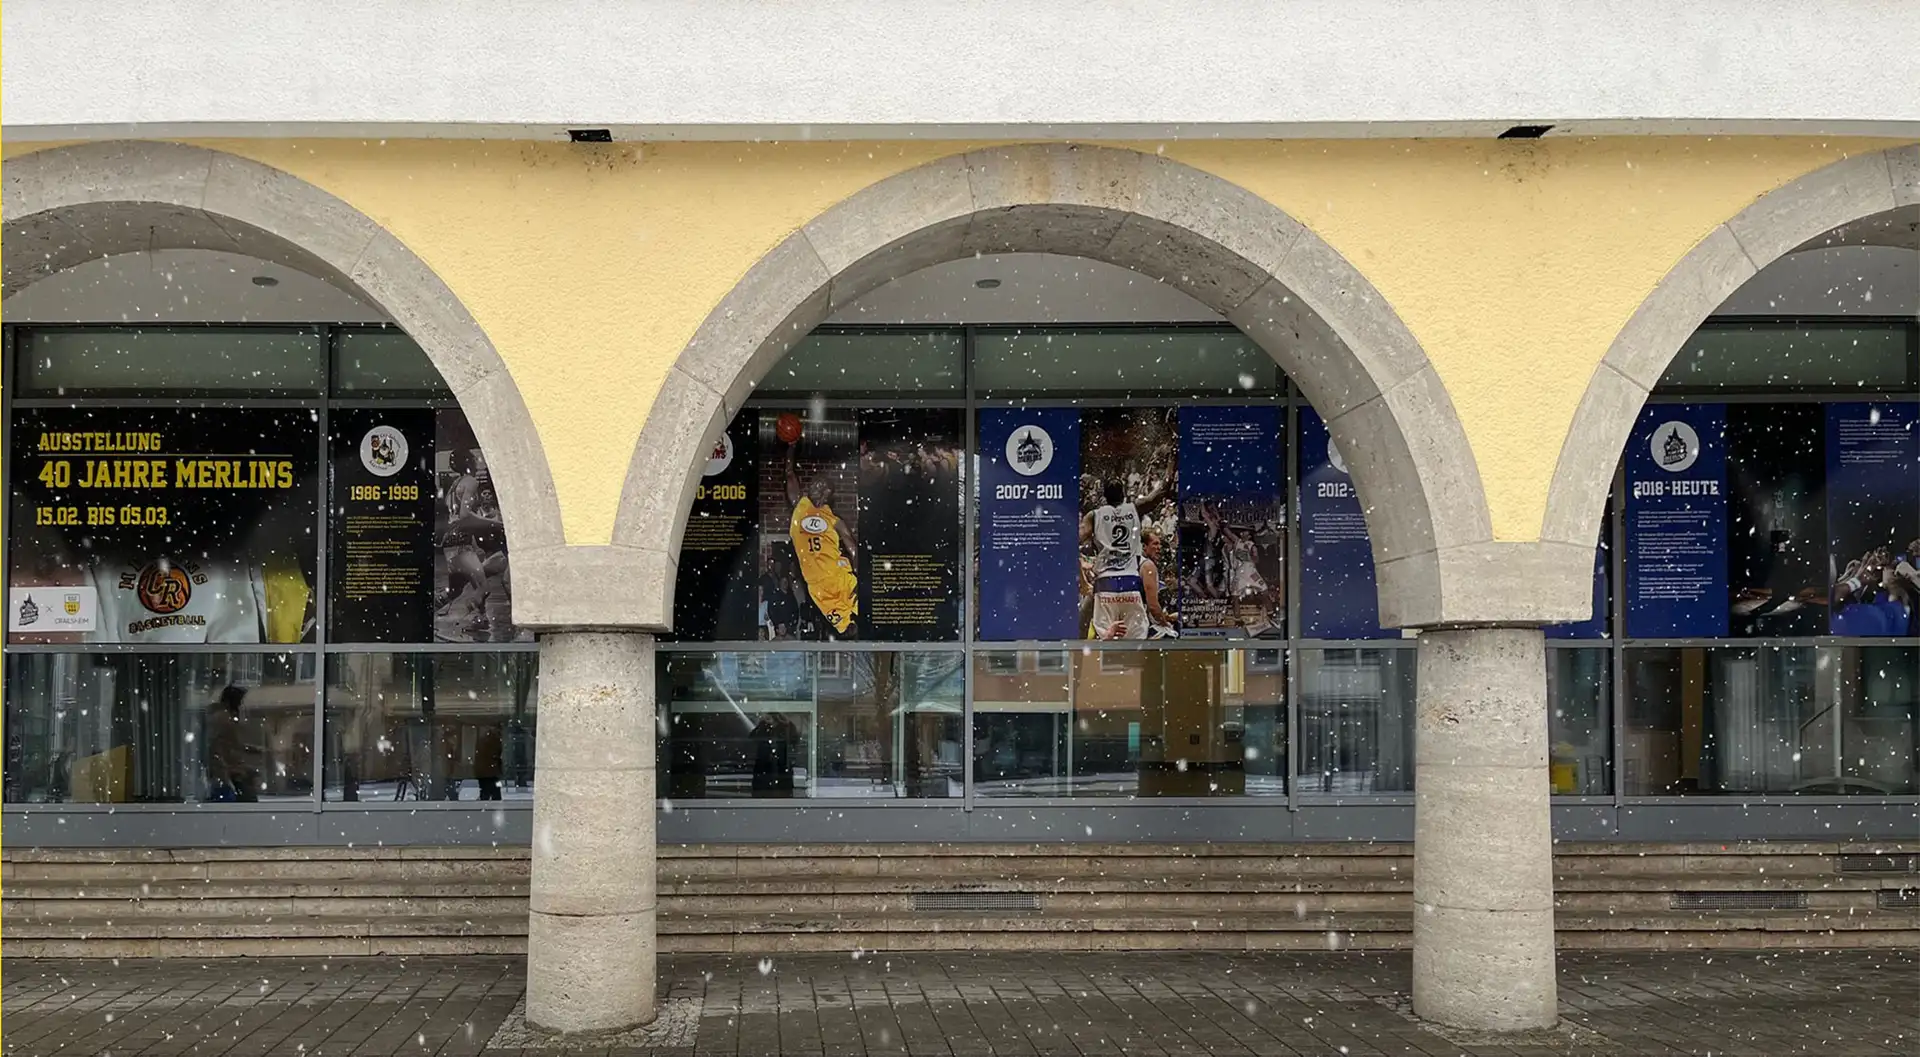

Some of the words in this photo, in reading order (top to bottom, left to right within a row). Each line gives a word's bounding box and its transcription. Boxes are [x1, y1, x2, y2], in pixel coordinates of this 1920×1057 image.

[38, 432, 161, 451] AUSSTELLUNG
[38, 461, 70, 488] 40
[78, 460, 167, 488] JAHRE
[175, 460, 293, 488] MERLINS
[36, 507, 82, 525] 15.02.
[87, 507, 115, 525] BIS
[120, 507, 171, 525] 05.03.
[808, 537, 821, 552] 15
[1111, 524, 1131, 550] 2
[128, 615, 206, 634] BASKETBALL
